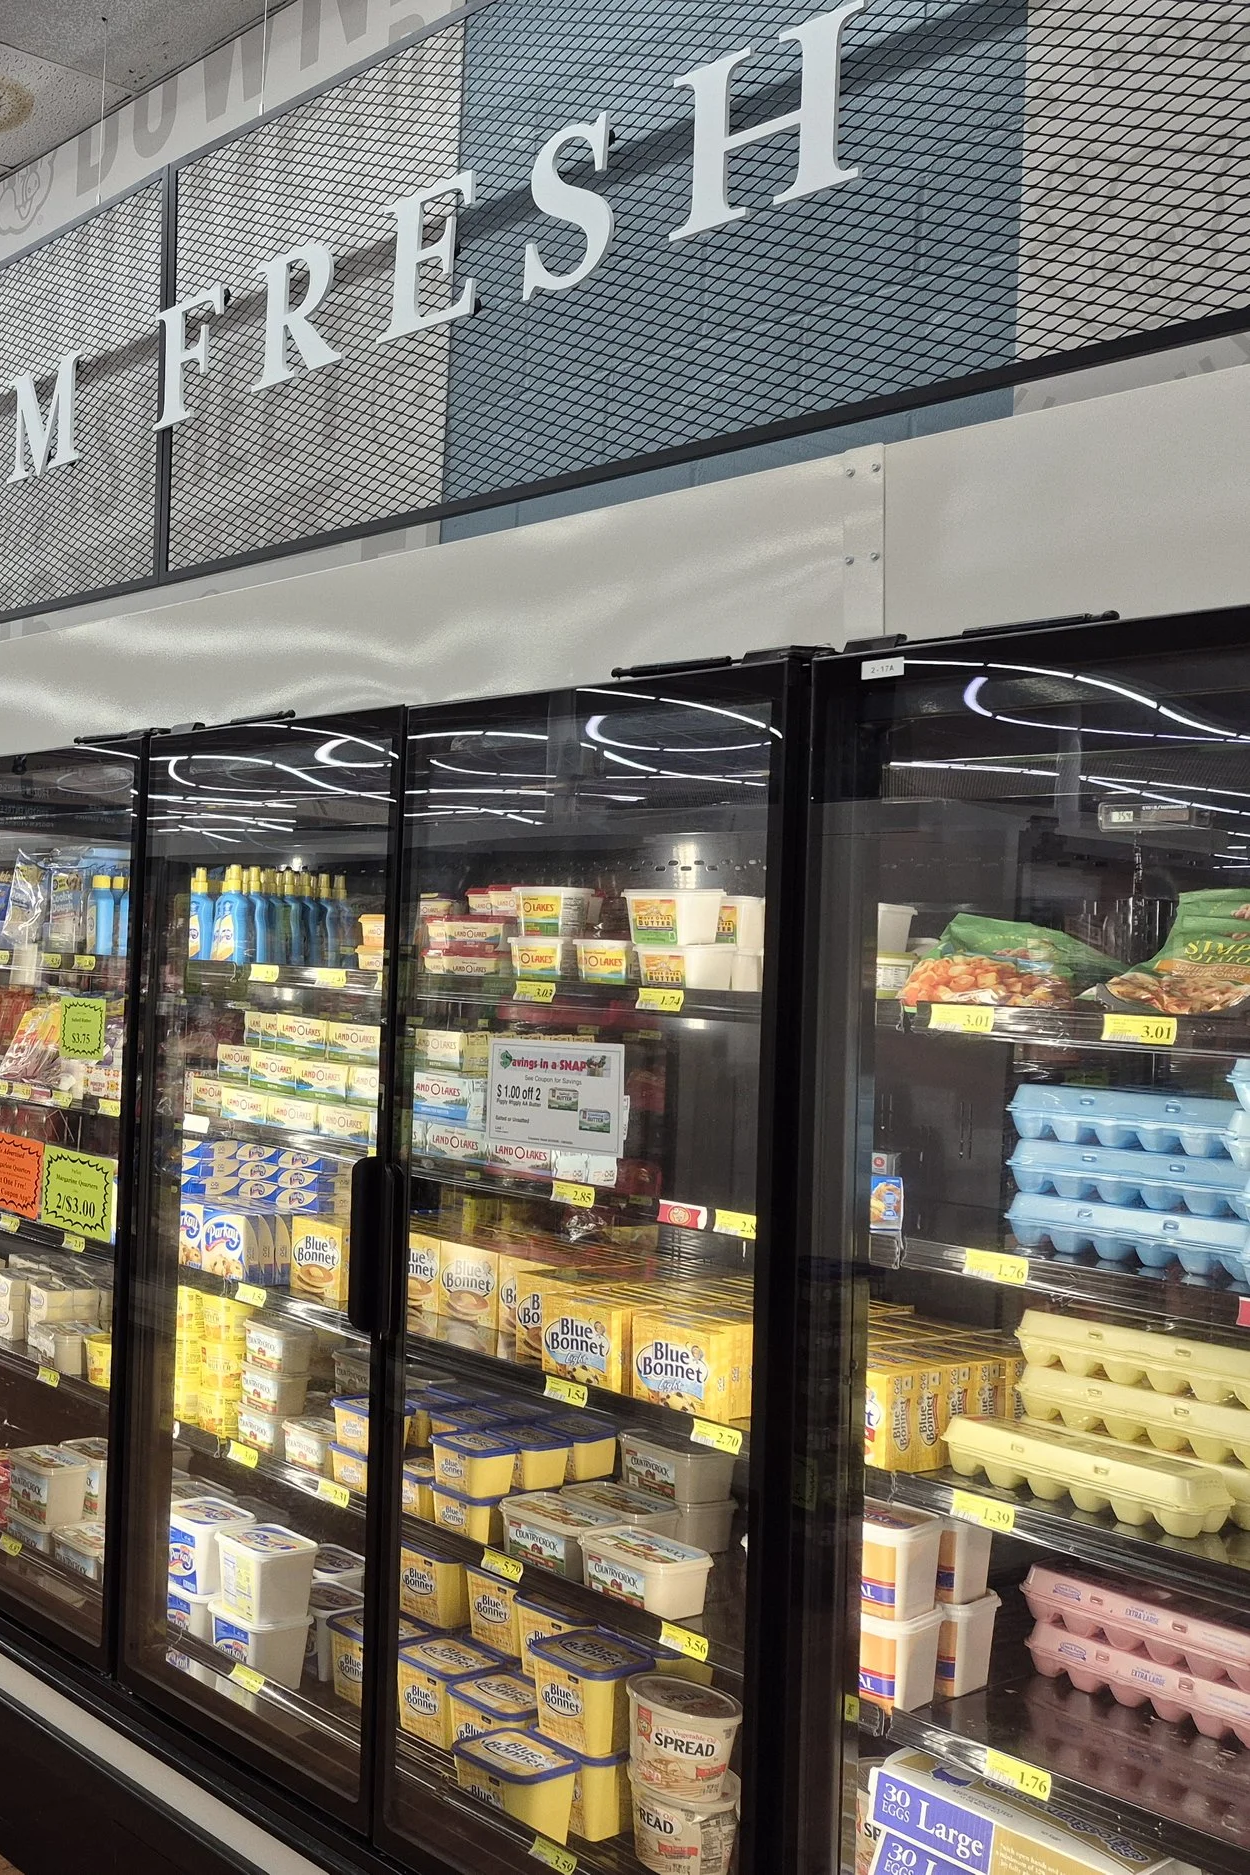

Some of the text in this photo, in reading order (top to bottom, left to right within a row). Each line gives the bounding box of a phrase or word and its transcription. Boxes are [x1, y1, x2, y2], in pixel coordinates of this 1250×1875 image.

[153, 0, 869, 432] FRESH
[869, 663, 896, 675] 2-17A
[531, 902, 555, 912] LAKES
[531, 954, 555, 964] LAKES
[660, 996, 681, 1006] 1.74
[962, 1013, 991, 1029] 3.01
[71, 1032, 91, 1045] $3.75
[1141, 1023, 1172, 1041] 3.01
[540, 1058, 549, 1070] in
[551, 1061, 557, 1070] a
[559, 1059, 588, 1073] SNAP
[504, 1085, 521, 1100] 1.00
[522, 1086, 534, 1101] off
[535, 1087, 542, 1101] 2
[432, 1134, 449, 1145] LAND
[460, 1139, 479, 1151] LAKES
[495, 1145, 513, 1156] LAND
[525, 1149, 548, 1161] LAKES
[55, 1173, 99, 1191] Margarine Quarters
[571, 1189, 593, 1203] 2.85
[56, 1192, 96, 1220] 2/$3.00
[207, 1223, 240, 1249] Parkay
[304, 1235, 328, 1253] Blue
[297, 1247, 337, 1266] Bonnet
[455, 1259, 482, 1279] Blue
[996, 1262, 1025, 1281] 1.76
[445, 1272, 492, 1293] Bonnet
[560, 1316, 593, 1340] Blue
[550, 1331, 605, 1357] Bonnet
[654, 1341, 690, 1365] Blue
[642, 1356, 704, 1384] Bonnet
[566, 1387, 586, 1402] 1.54
[892, 1409, 900, 1440] Blue
[899, 1397, 908, 1447] Bonnet
[919, 1404, 927, 1434] Blue
[926, 1393, 935, 1441] Bonnet
[715, 1431, 740, 1449] 2.70
[444, 1457, 458, 1469] Blue
[445, 1506, 459, 1517] Blue
[982, 1507, 1011, 1526] 1.39
[409, 1567, 428, 1581] Blue
[501, 1561, 521, 1577] 5.79
[404, 1575, 434, 1593] Bonnet
[482, 1594, 500, 1609] Blue
[477, 1602, 510, 1620] Bonnet
[1124, 1607, 1143, 1620] EXTRA
[684, 1636, 707, 1656] 3.56
[344, 1655, 362, 1669] Blue
[1130, 1668, 1148, 1681] EXTRA
[411, 1684, 431, 1701] Blue
[550, 1683, 572, 1700] Blue
[406, 1692, 439, 1714] Bonnet
[544, 1691, 581, 1715] Bonnet
[654, 1732, 716, 1758] SPREAD
[1018, 1770, 1048, 1794] 1.76
[883, 1782, 911, 1809] 30
[881, 1800, 911, 1824] EGGS
[916, 1798, 985, 1864] Large
[887, 1841, 918, 1870] 30
